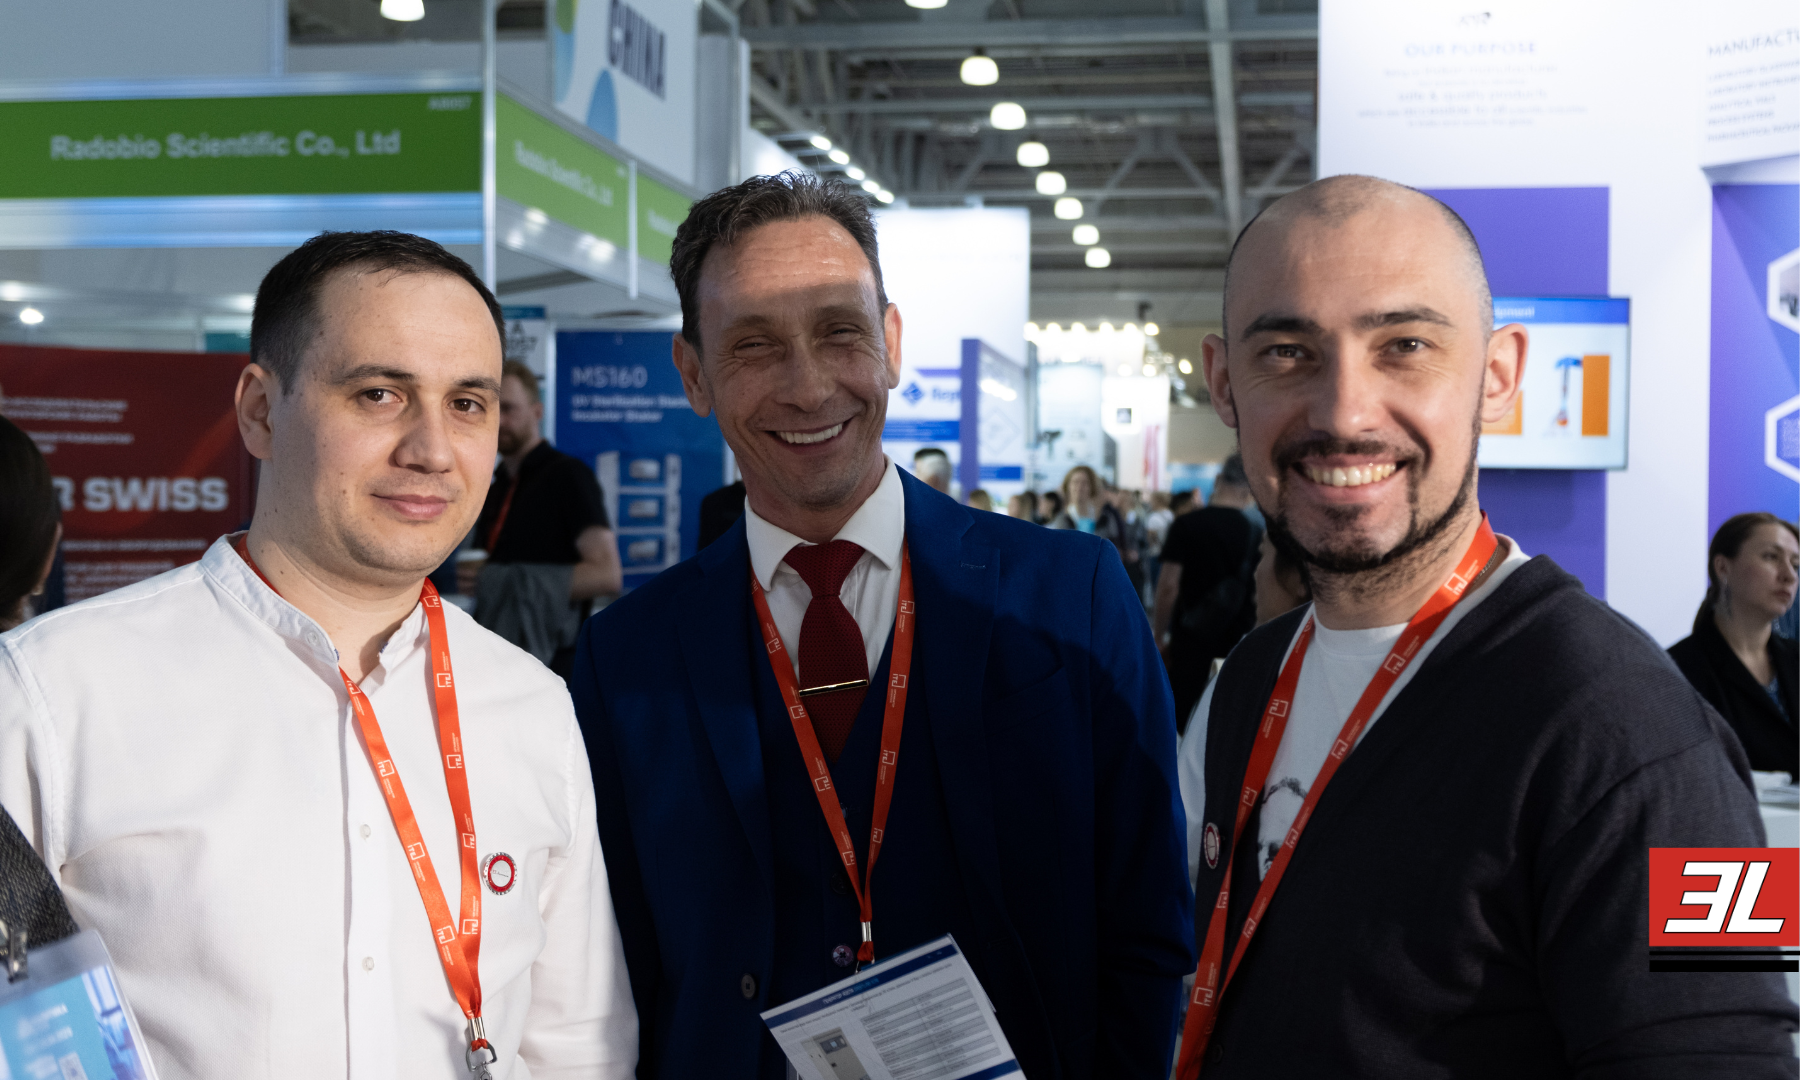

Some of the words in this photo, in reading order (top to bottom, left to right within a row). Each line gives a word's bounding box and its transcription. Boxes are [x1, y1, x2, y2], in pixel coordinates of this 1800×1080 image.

[50, 134, 160, 160] Radobio
[166, 129, 290, 160] Scientific
[295, 129, 350, 159] Co.,
[355, 128, 402, 157] Ltd
[571, 365, 648, 389] MS160
[83, 475, 229, 512] SWISS
